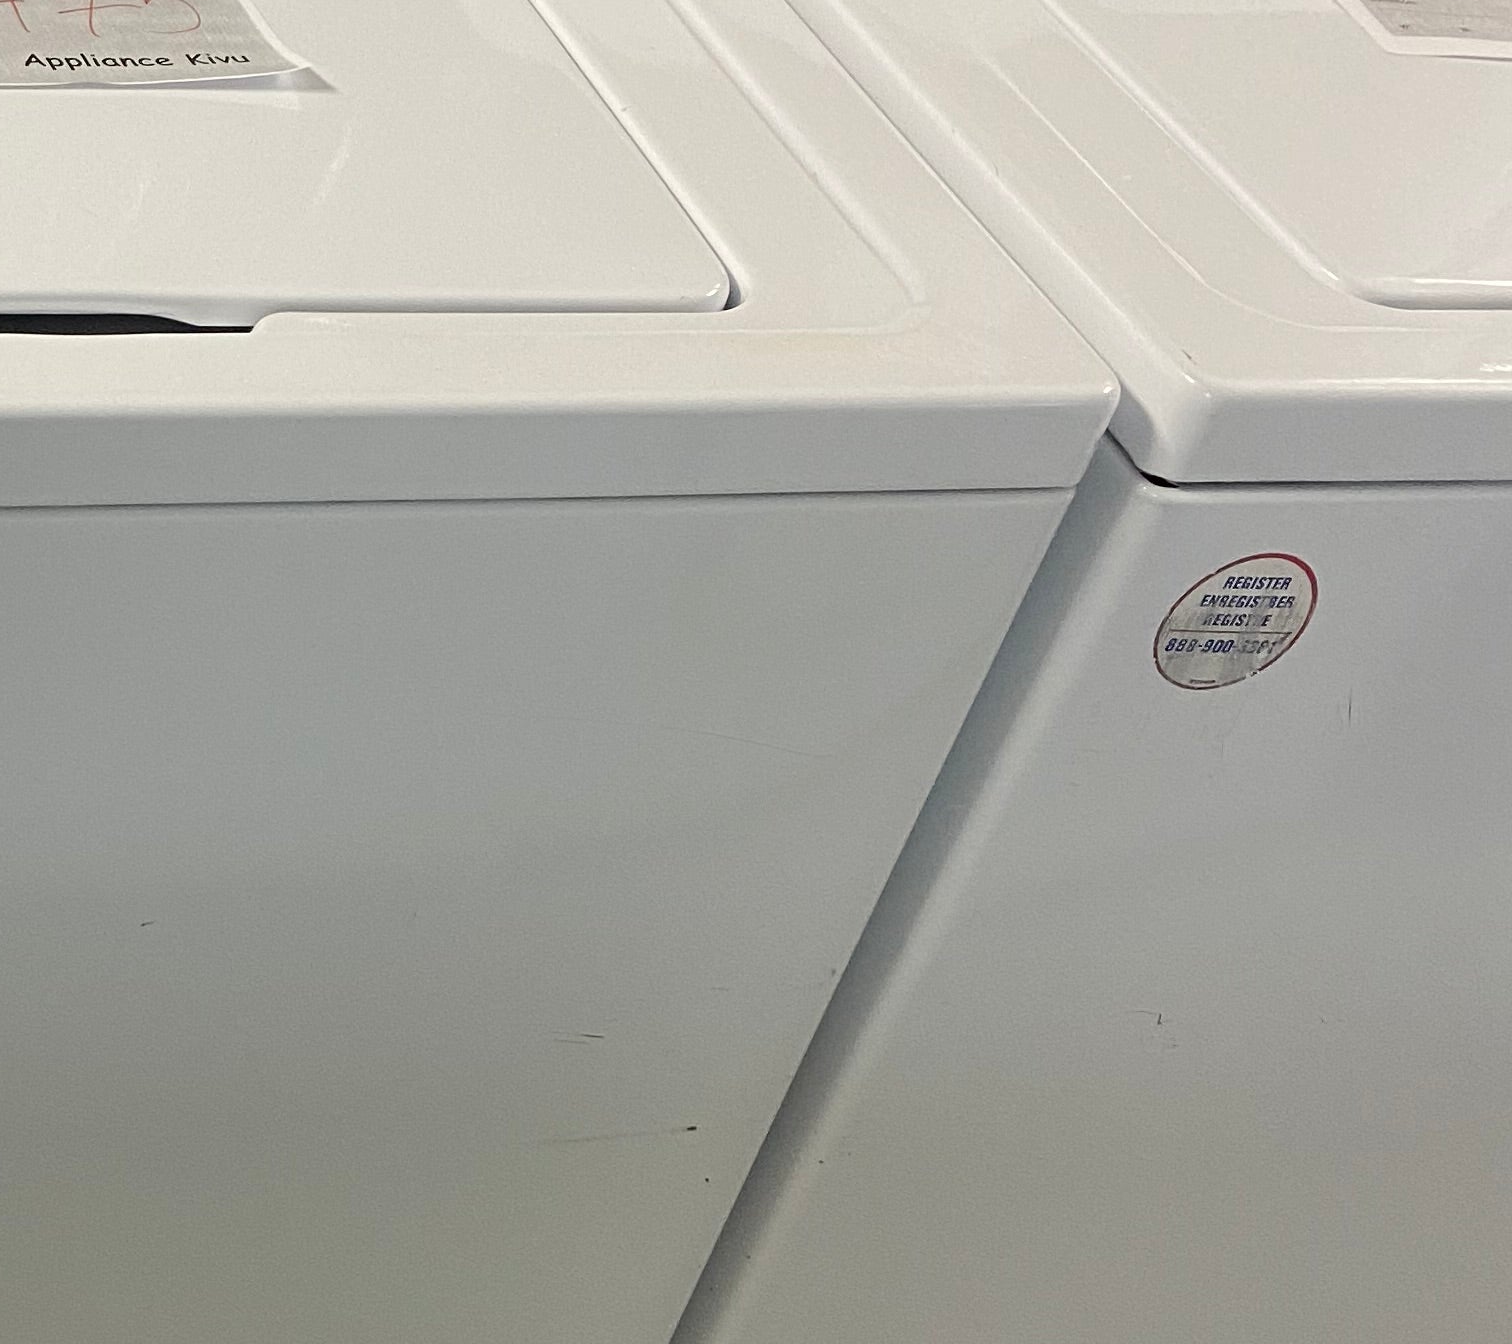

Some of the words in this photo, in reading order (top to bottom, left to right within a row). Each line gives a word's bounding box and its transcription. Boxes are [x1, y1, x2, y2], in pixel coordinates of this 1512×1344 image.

[24, 53, 174, 71] Appliance
[185, 53, 252, 66] Kivu
[1223, 576, 1292, 590] REGISTER
